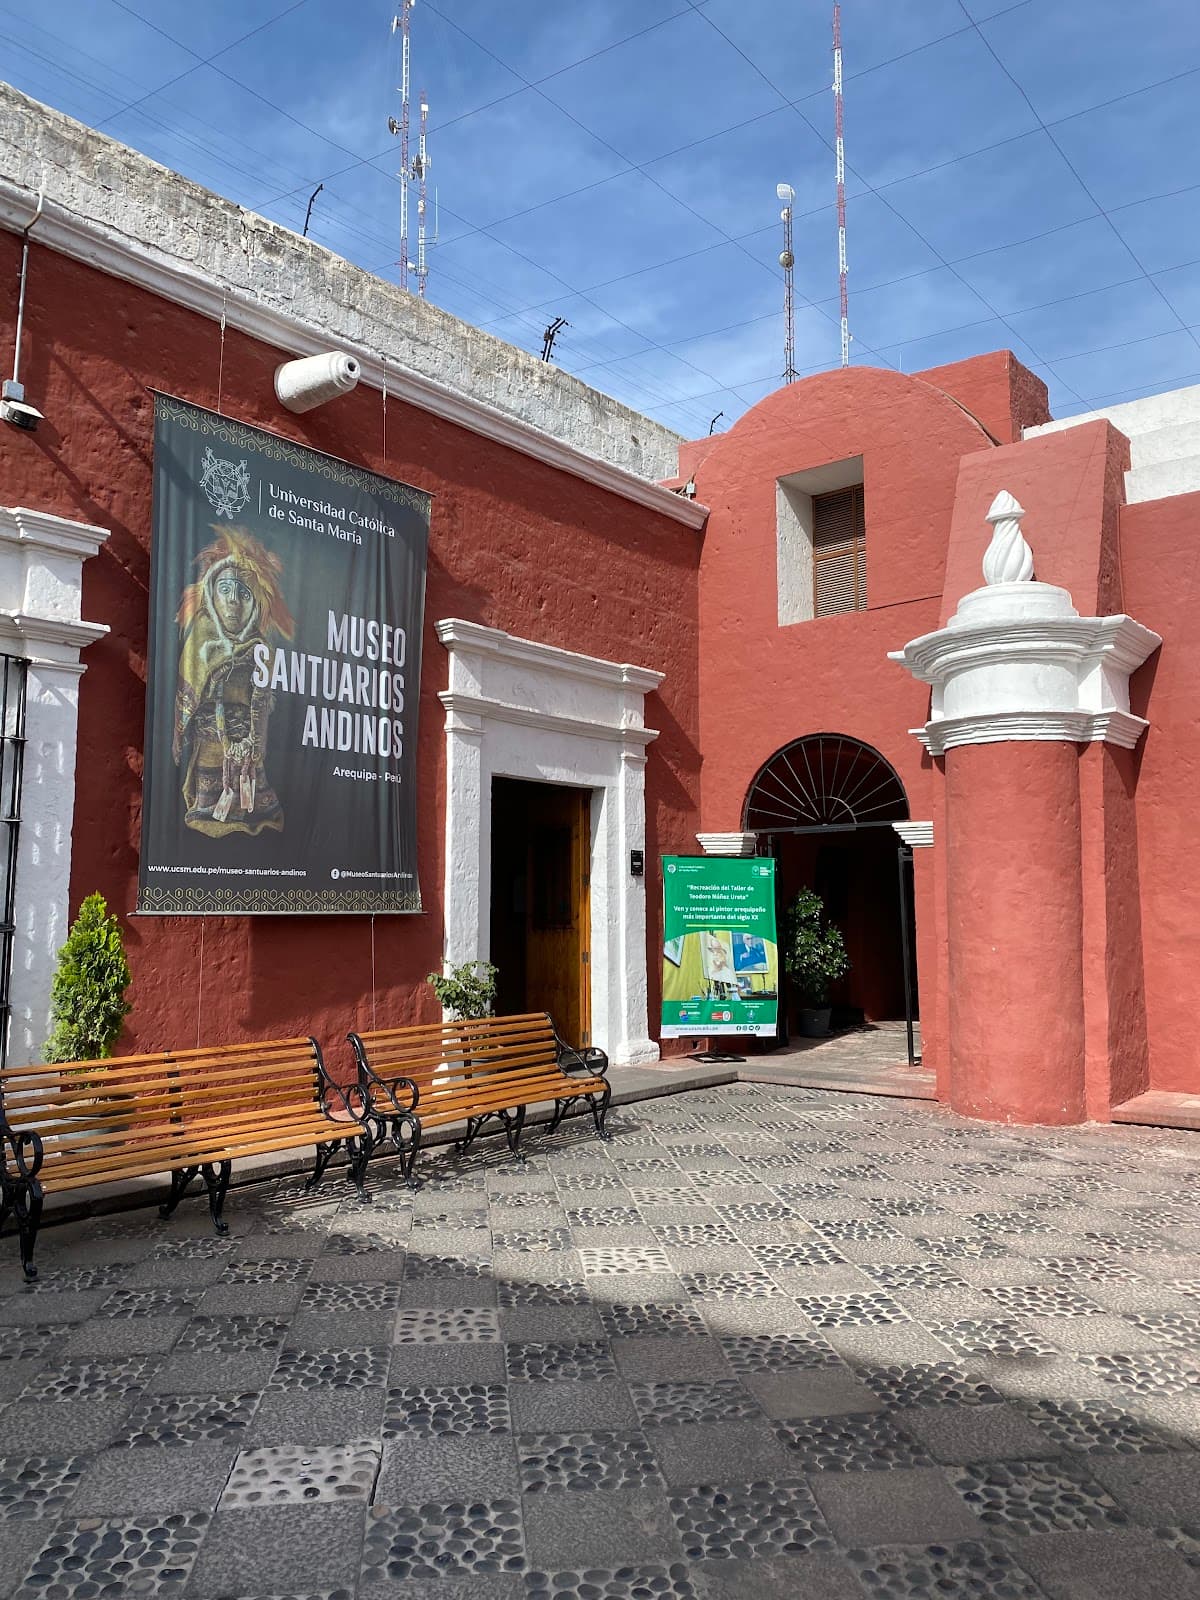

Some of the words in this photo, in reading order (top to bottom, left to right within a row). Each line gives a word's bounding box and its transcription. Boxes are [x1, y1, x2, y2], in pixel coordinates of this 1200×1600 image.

[268, 504, 285, 520] de
[288, 510, 324, 533] Santa
[327, 522, 362, 545] María
[269, 483, 346, 520] Universidad
[348, 511, 395, 537] Católica
[327, 609, 406, 668] MUSEO
[253, 643, 405, 713] SANTUARIOS
[301, 705, 404, 760] ANDINOS
[332, 766, 377, 781] Arequipa
[147, 864, 307, 877] www.ucsm.edu.pe/museo-santuarios-andinos
